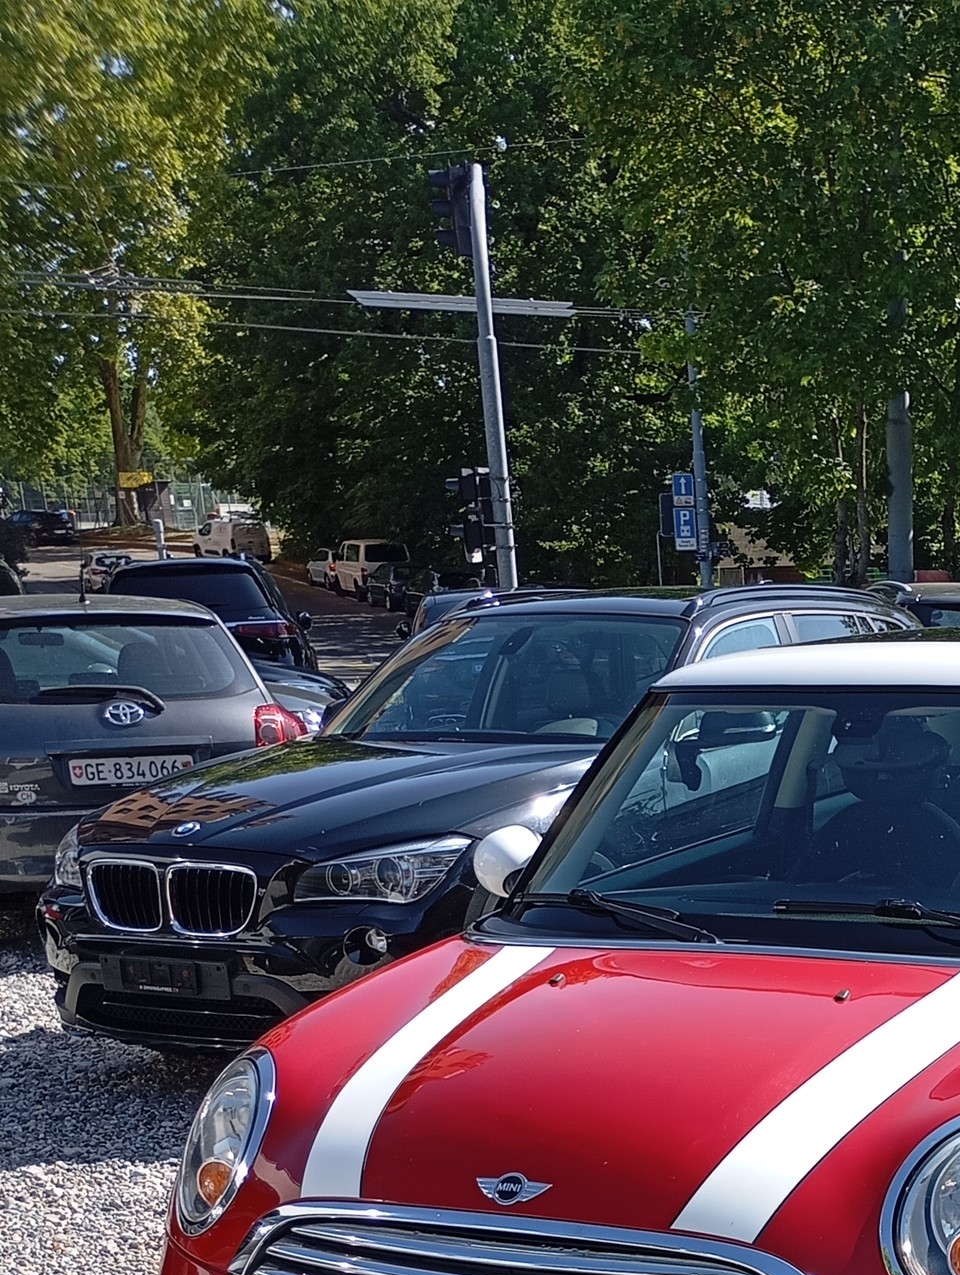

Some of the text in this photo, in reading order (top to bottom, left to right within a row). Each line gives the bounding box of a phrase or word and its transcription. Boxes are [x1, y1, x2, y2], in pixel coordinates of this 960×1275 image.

[680, 511, 690, 525] P
[20, 793, 33, 801] CH
[496, 1182, 522, 1193] MINI
